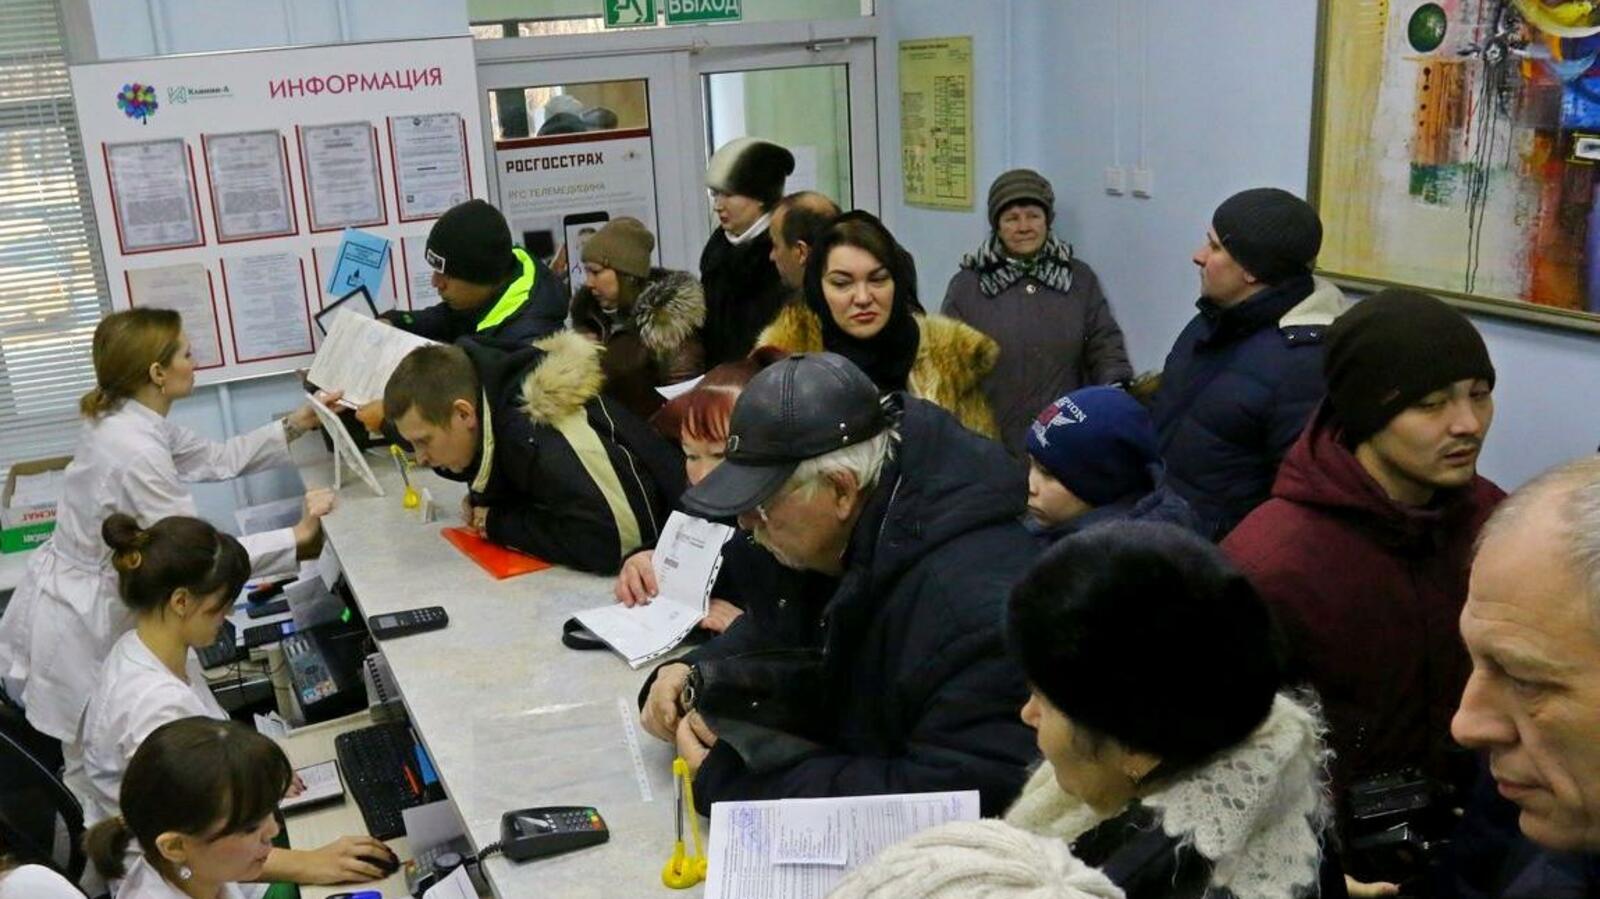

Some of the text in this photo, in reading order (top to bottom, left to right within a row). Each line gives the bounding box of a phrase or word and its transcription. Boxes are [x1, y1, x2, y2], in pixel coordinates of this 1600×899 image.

[669, 0, 740, 15] ВЫХОД
[268, 66, 443, 99] ИНФОРМАЦИЯ
[505, 152, 605, 173] РОСГОССТРАХ
